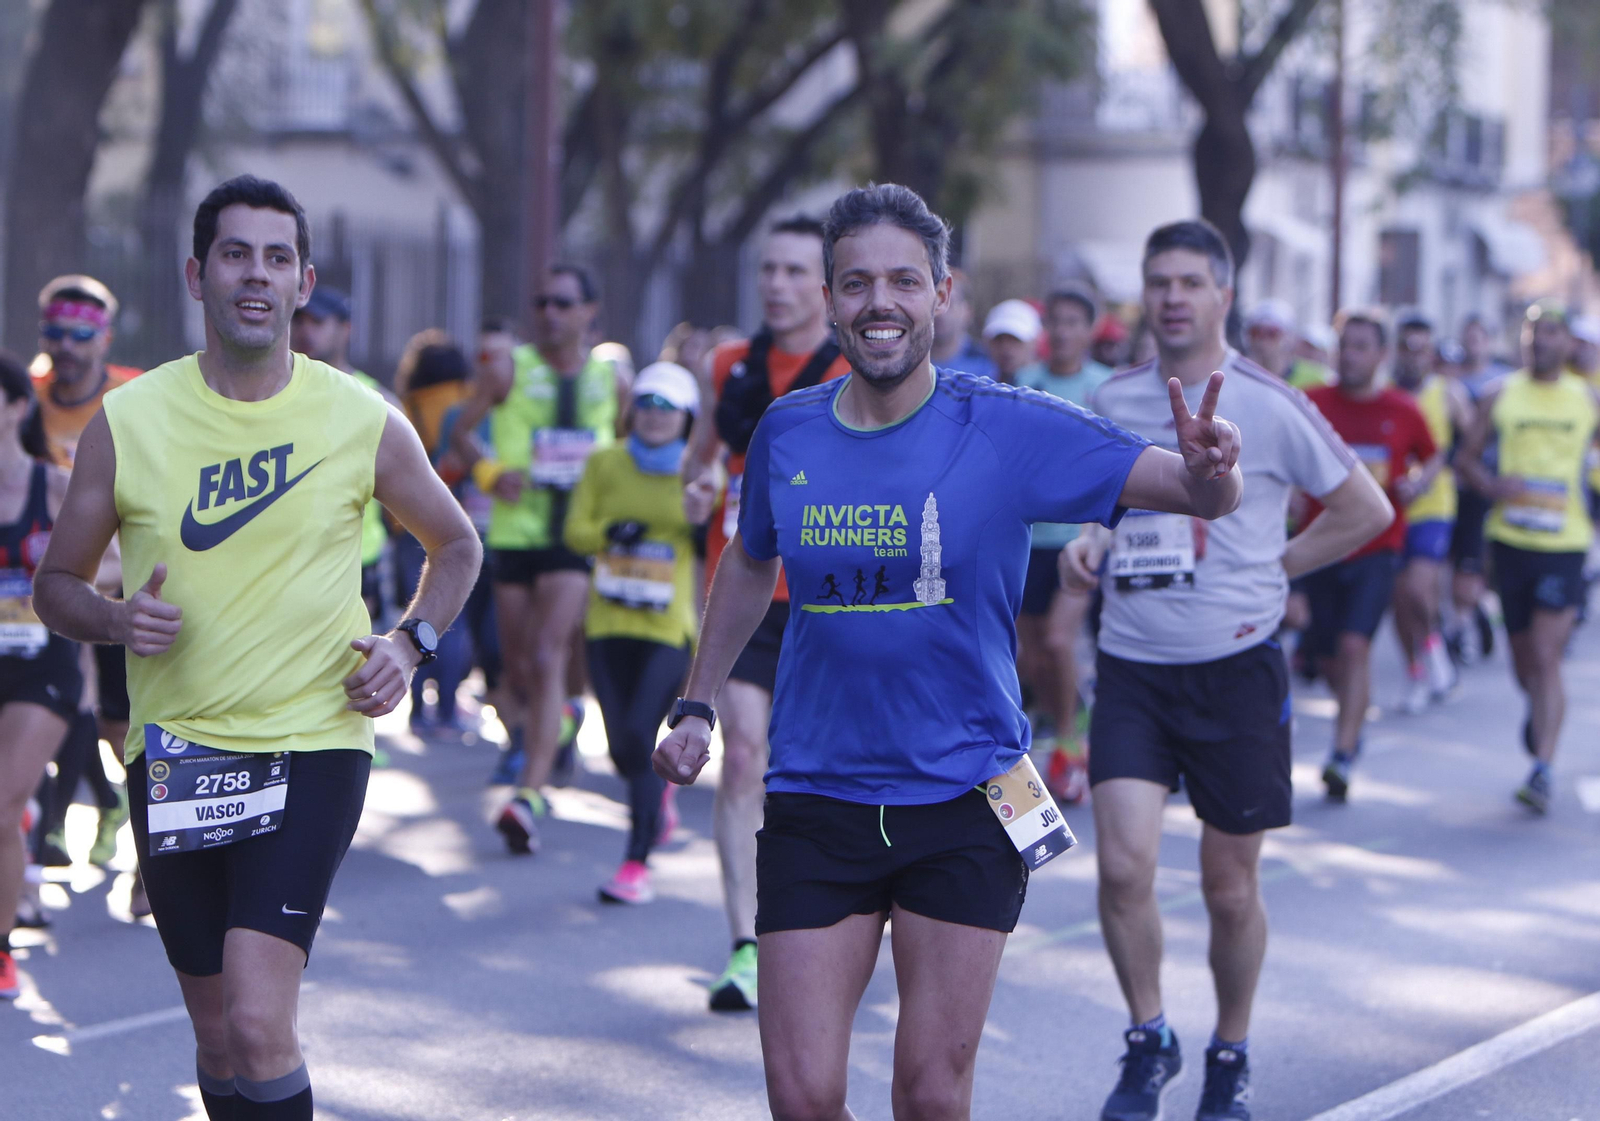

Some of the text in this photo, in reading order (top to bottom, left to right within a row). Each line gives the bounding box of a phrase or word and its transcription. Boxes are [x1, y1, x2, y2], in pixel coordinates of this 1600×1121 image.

[197, 442, 294, 511] FAST
[802, 504, 909, 526] INVICTA
[800, 528, 907, 546] RUNNERS
[873, 546, 908, 557] team
[195, 770, 251, 795] 2758
[1028, 779, 1043, 799] 3
[195, 801, 245, 822] VASCO
[250, 824, 277, 836] ZURICH
